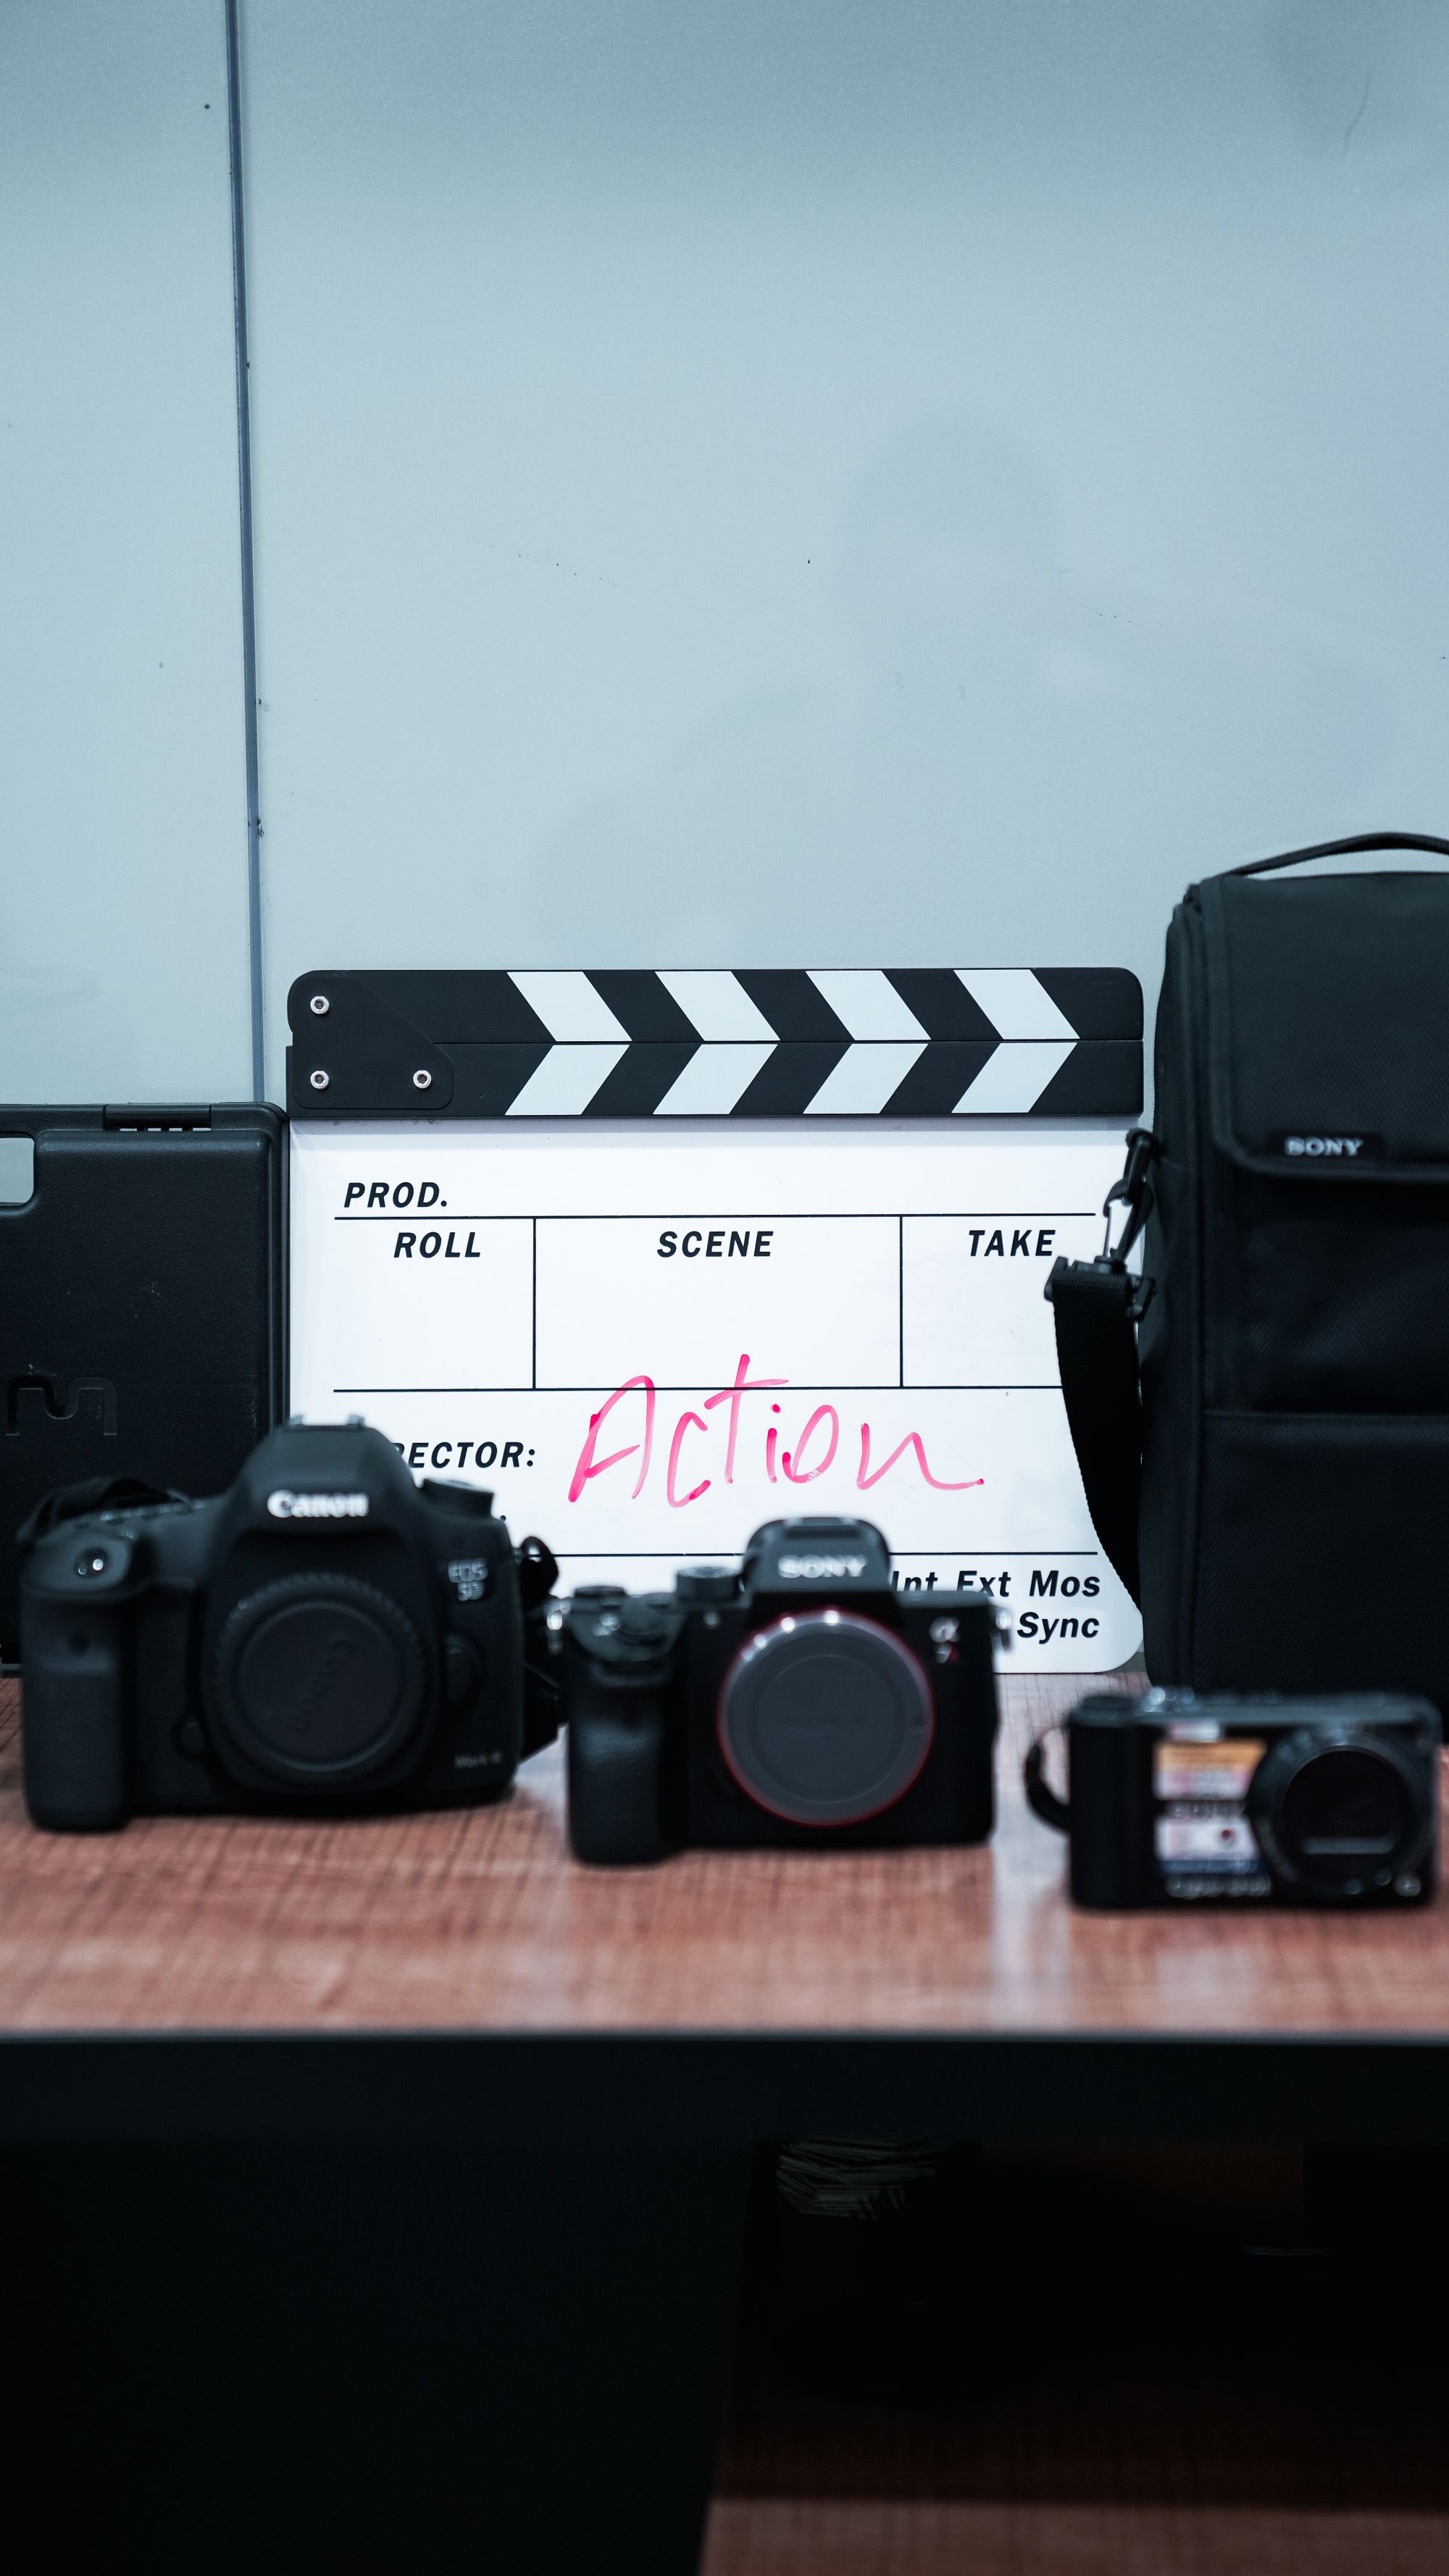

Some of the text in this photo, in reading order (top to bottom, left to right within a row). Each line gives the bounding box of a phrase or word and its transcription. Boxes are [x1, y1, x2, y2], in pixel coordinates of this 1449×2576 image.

[1285, 1137, 1363, 1156] SONY
[343, 1182, 448, 1208] PROD.
[393, 1231, 482, 1259] ROLL
[656, 1230, 774, 1258] SCENE
[967, 1229, 1056, 1257] TAKE
[567, 1353, 985, 1507] Action
[267, 1489, 370, 1518] Canon
[448, 1558, 488, 1583] EOS
[777, 1554, 868, 1579] SONY
[890, 1570, 1101, 1598] Int Ext Mos
[1016, 1611, 1101, 1645] Sync
